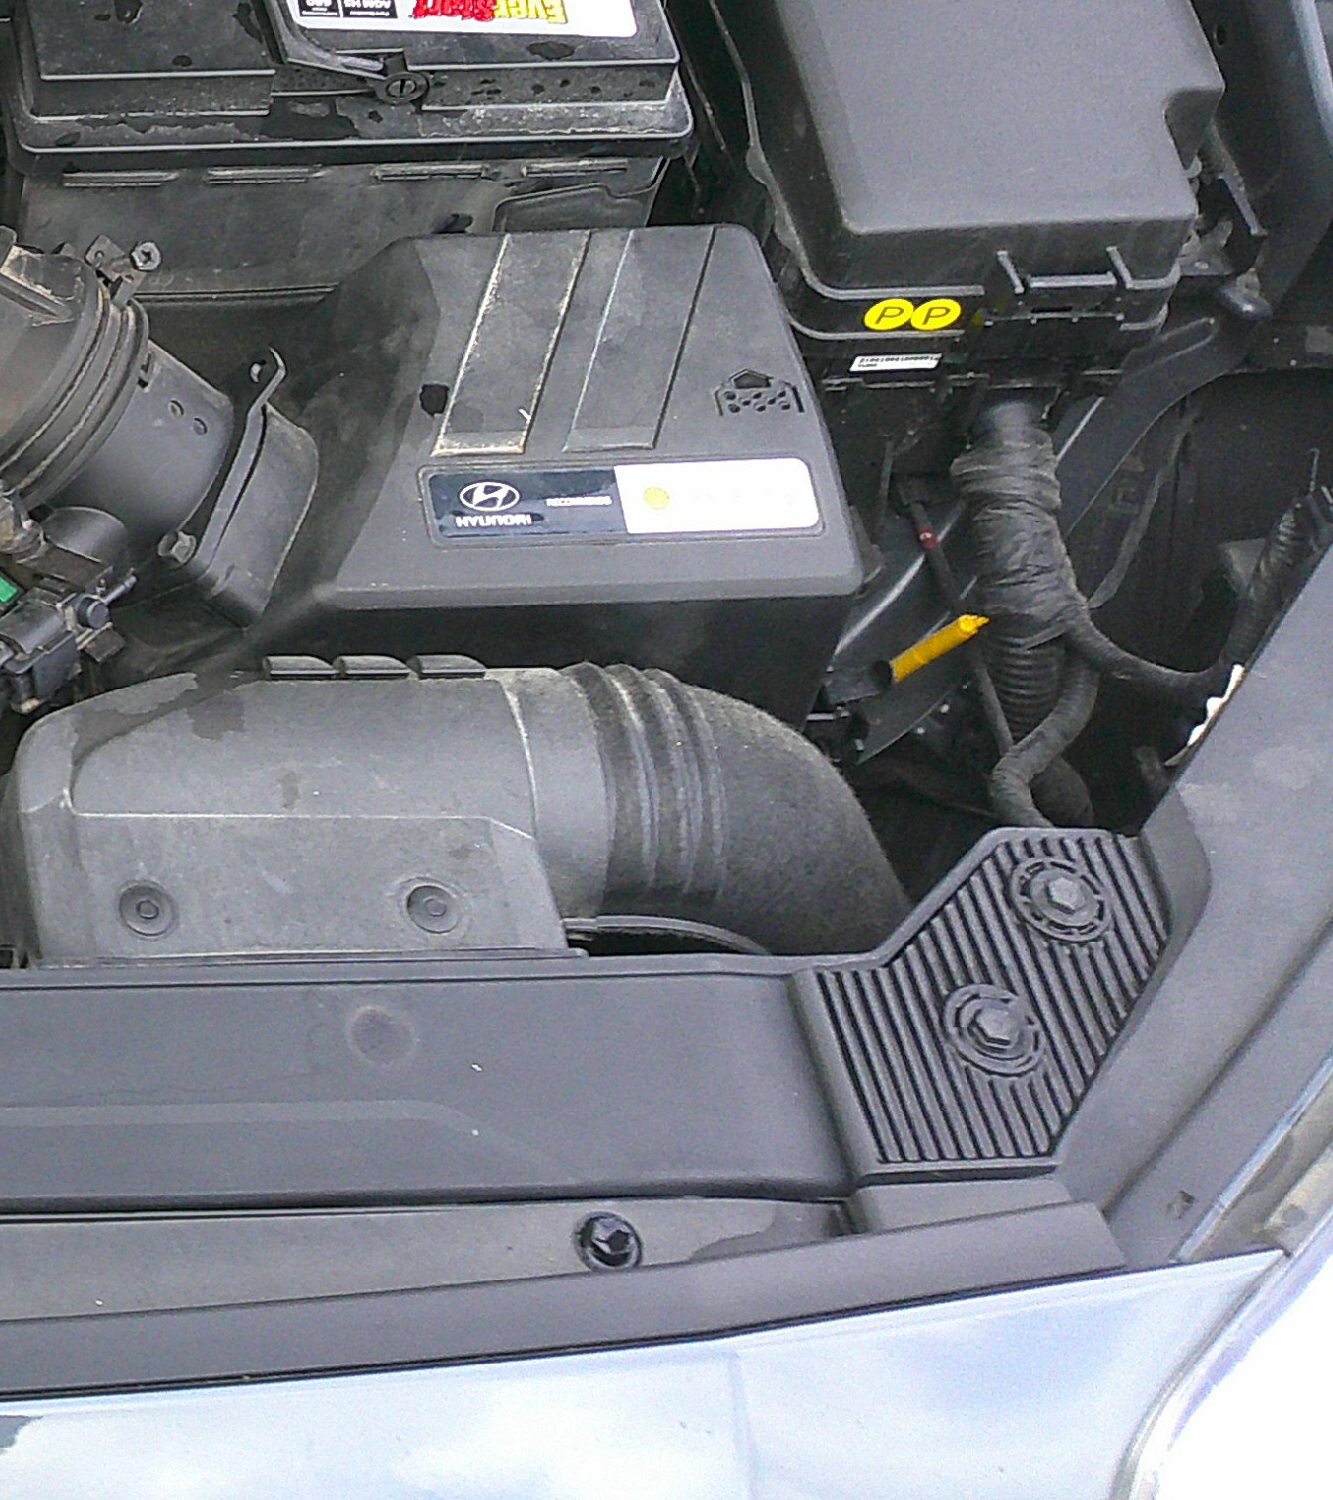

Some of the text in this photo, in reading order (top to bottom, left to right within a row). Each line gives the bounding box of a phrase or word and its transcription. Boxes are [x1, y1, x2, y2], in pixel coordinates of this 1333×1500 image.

[874, 306, 951, 326] P P
[455, 513, 533, 528] HYUNDAI
